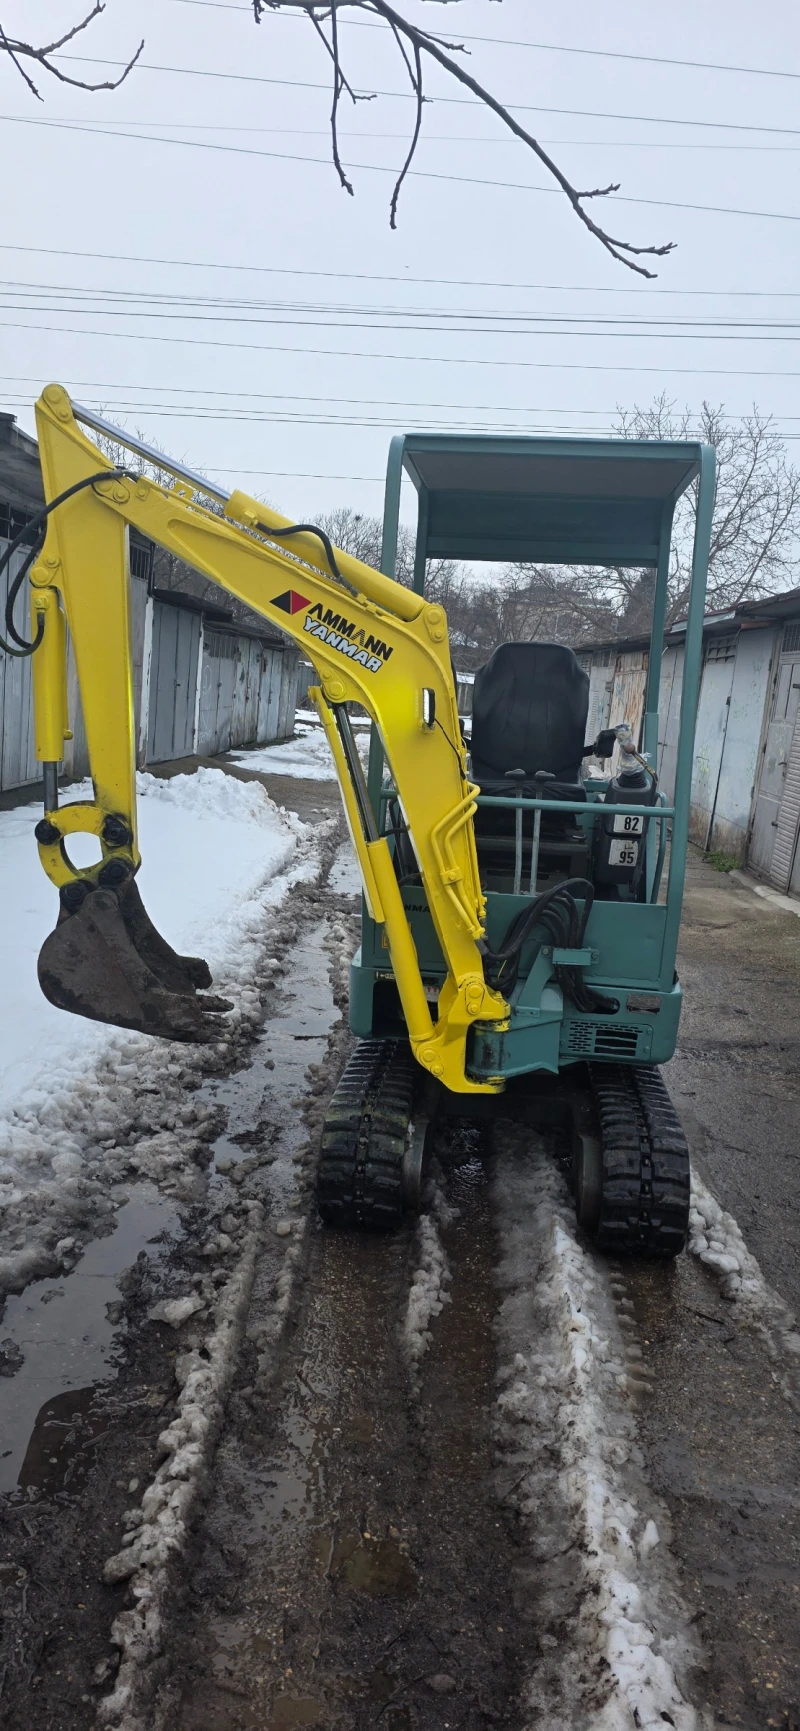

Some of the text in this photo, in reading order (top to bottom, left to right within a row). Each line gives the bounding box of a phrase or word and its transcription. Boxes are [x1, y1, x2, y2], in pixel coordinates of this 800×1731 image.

[308, 603, 393, 661] AMMANN
[303, 615, 383, 673] YANMAR
[624, 816, 640, 831] 82
[619, 851, 635, 864] 95
[404, 904, 430, 913] NMA
